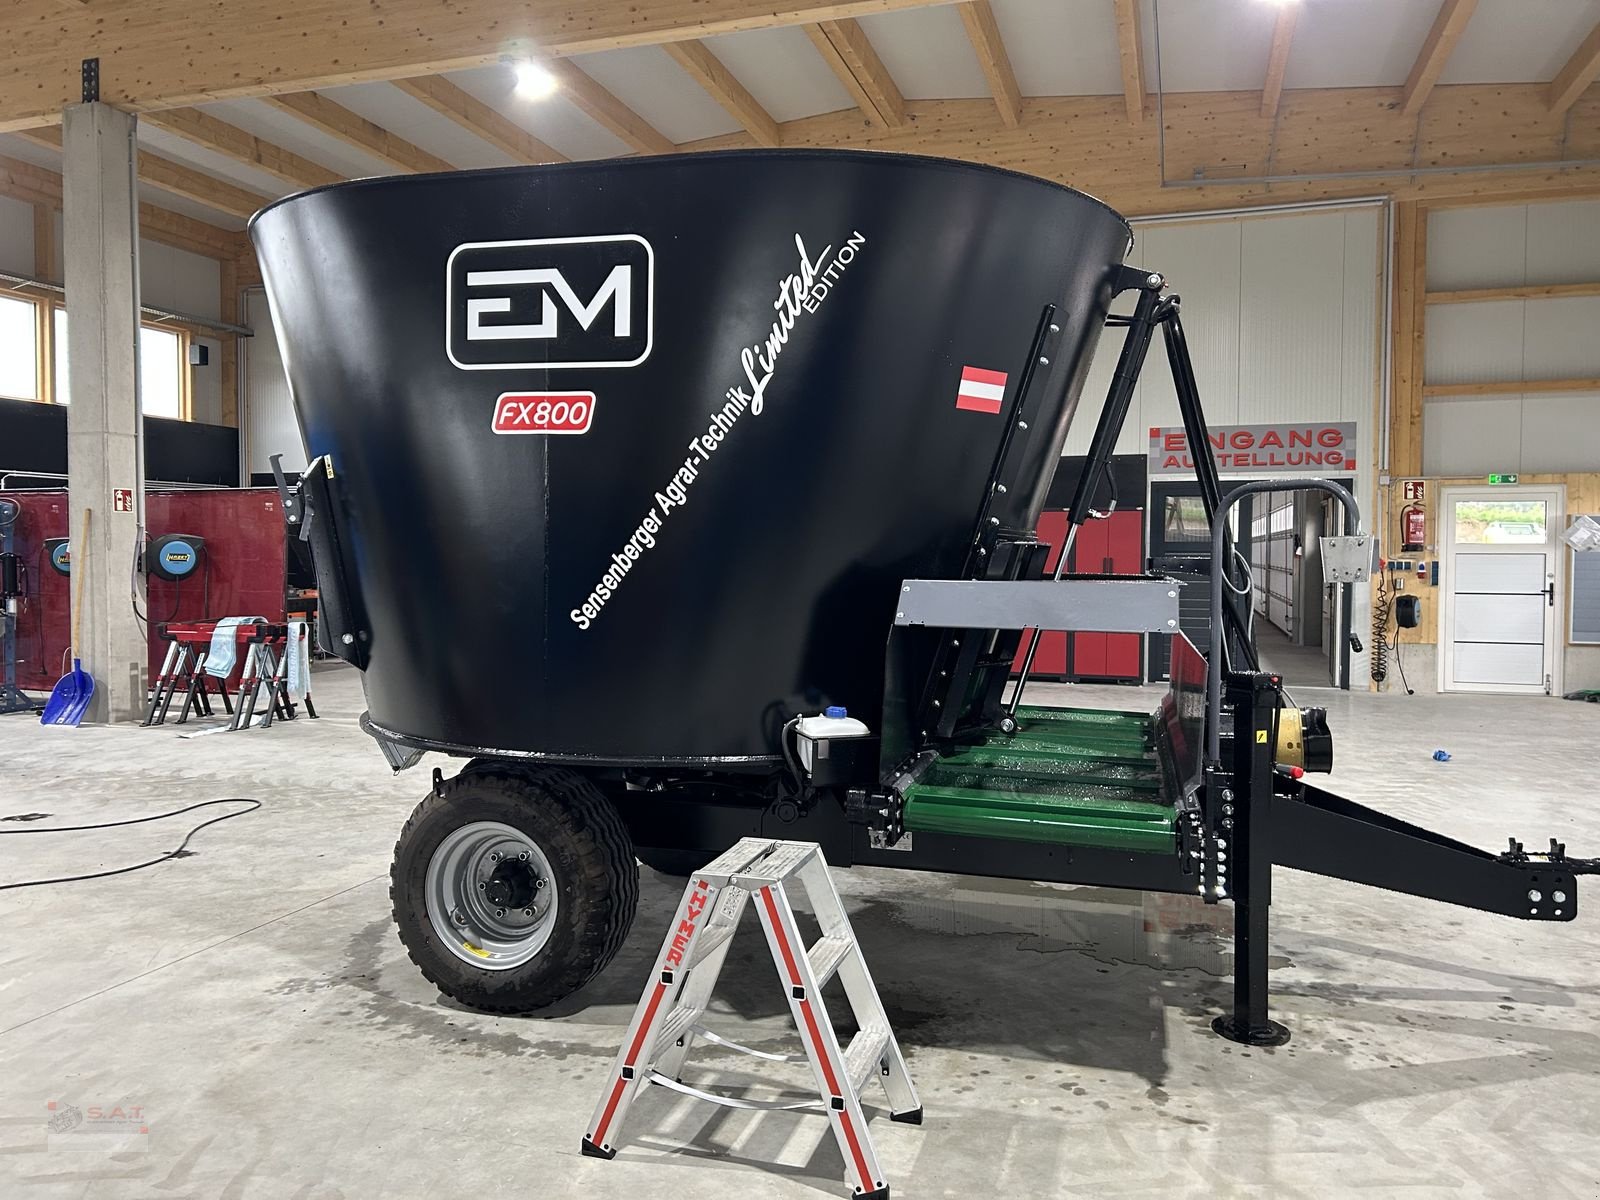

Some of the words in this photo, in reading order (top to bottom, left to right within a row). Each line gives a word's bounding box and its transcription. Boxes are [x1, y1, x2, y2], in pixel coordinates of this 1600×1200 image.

[467, 264, 632, 341] EM
[802, 230, 867, 315] EDITION
[741, 232, 832, 416] Limited
[498, 400, 587, 426] FX800
[1164, 428, 1345, 451] ENGANG
[1163, 451, 1344, 468] AUTELLUNG
[570, 511, 662, 631] Sensenberger
[654, 384, 753, 516] Agrar-Technik
[666, 891, 707, 967] HYMER
